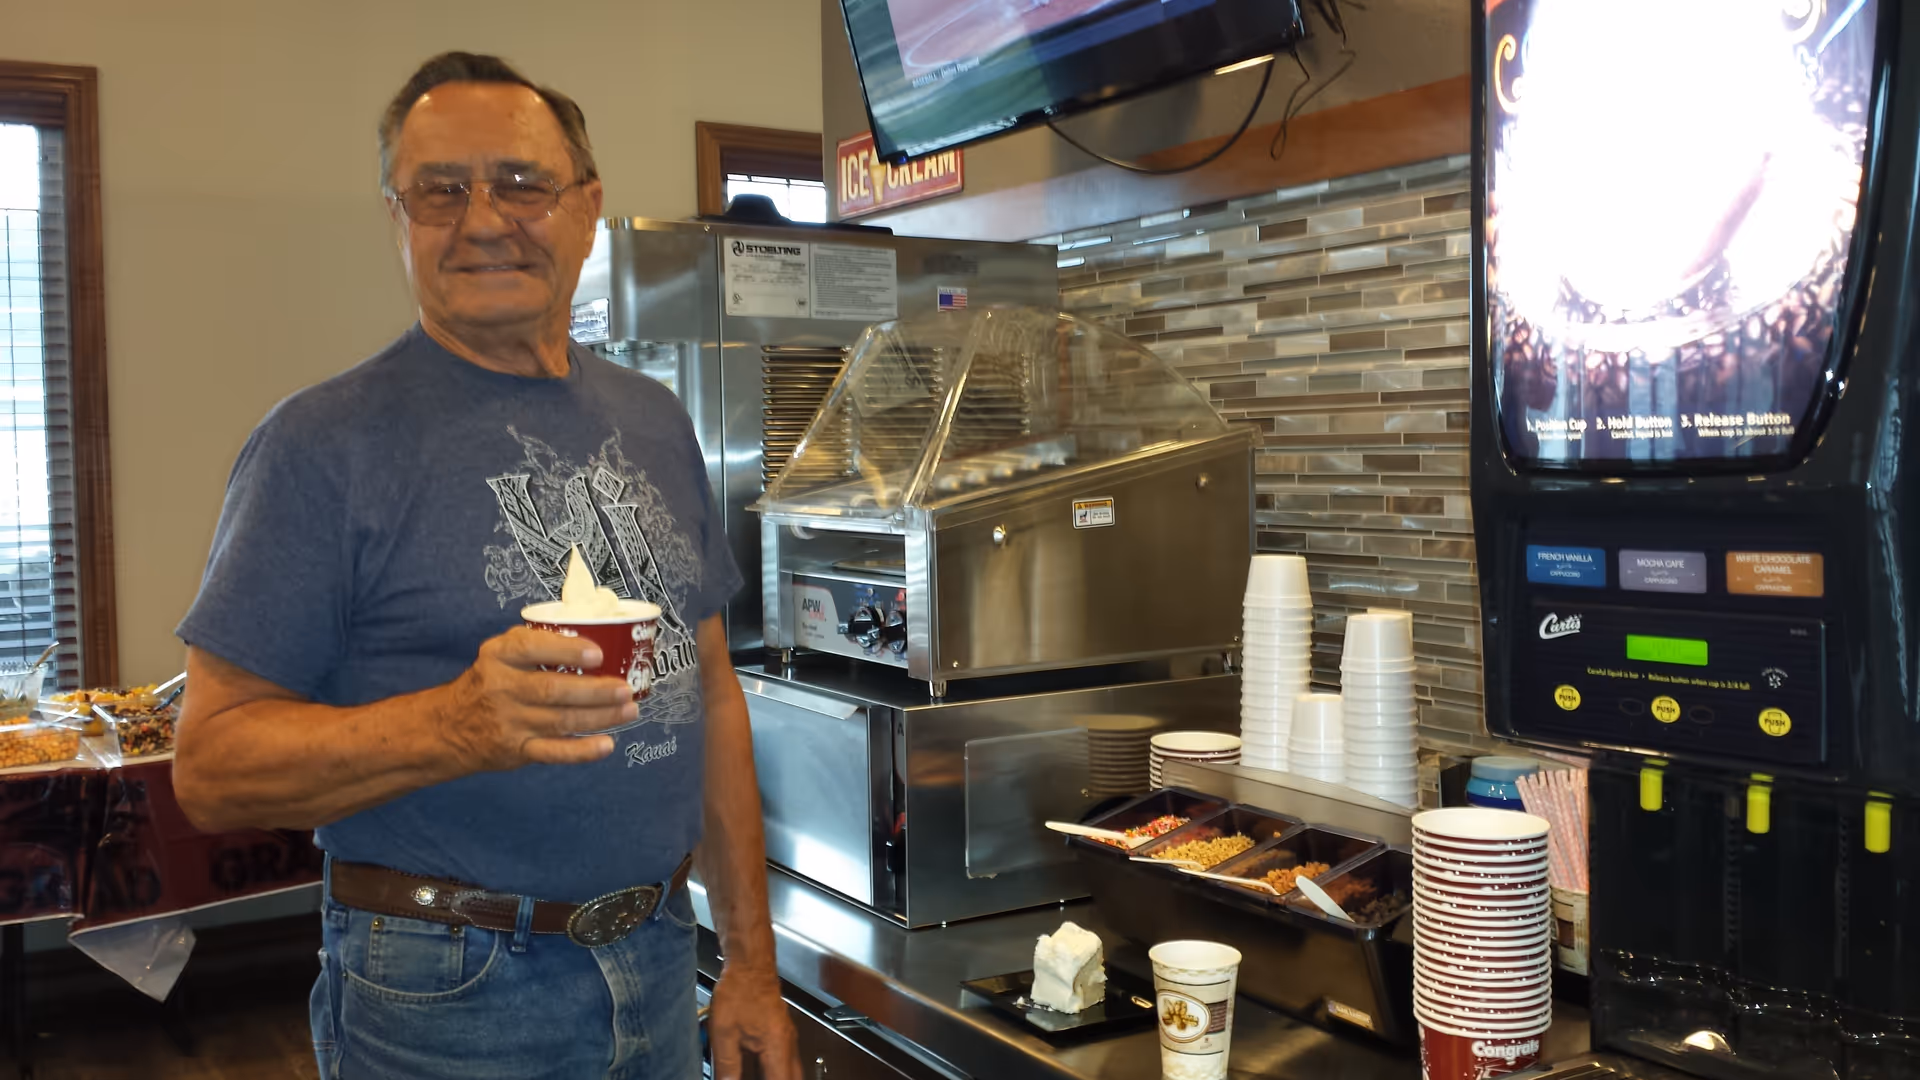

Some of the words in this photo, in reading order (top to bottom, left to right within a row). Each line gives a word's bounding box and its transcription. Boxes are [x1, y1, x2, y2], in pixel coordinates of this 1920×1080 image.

[841, 149, 870, 203] ICE
[746, 245, 801, 256] STOELTING
[1569, 418, 1588, 433] Cup
[1607, 415, 1634, 430] Hold
[1635, 414, 1673, 429] Button
[1694, 412, 1744, 427] Release
[1746, 411, 1791, 426] Button
[1539, 612, 1581, 640] Curtis
[1559, 694, 1577, 702] PUSH
[1656, 704, 1676, 714] PUSH
[1764, 718, 1786, 727] PUSH
[1471, 1040, 1540, 1060] Congrats
